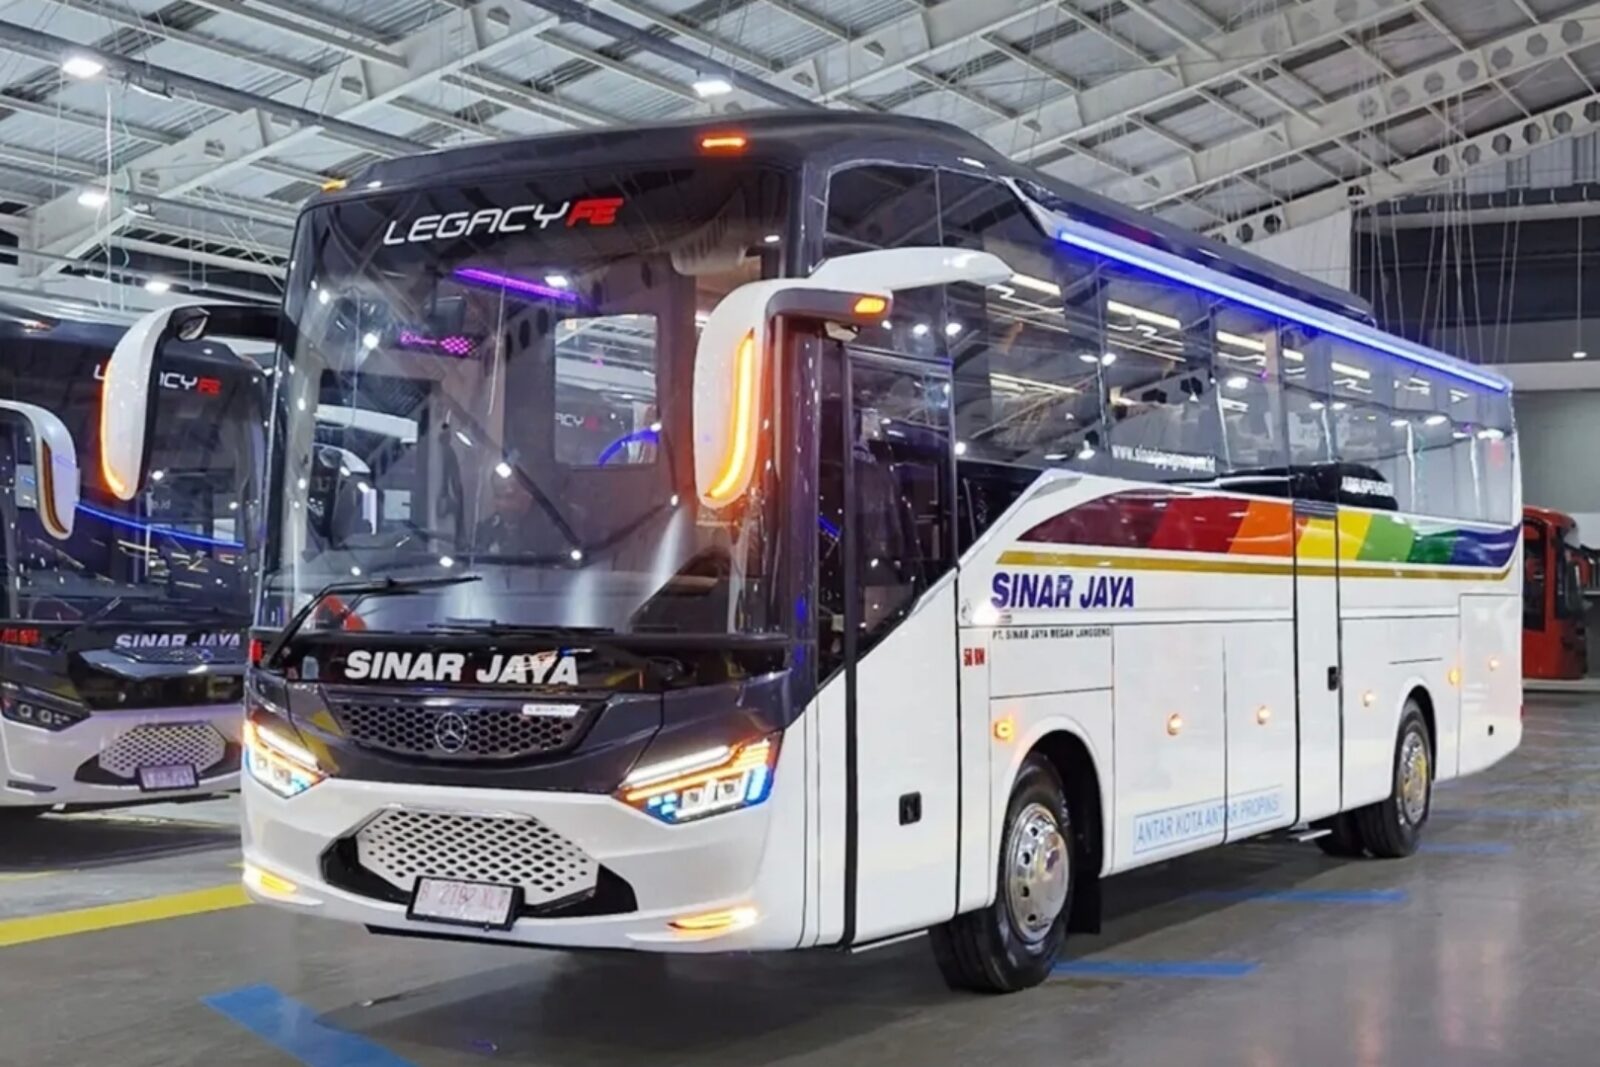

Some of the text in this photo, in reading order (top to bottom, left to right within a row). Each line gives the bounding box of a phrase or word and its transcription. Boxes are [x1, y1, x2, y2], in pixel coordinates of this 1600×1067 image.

[383, 201, 570, 245] LEGACY
[990, 572, 1134, 608] SINAR JAYA
[114, 633, 241, 649] SINAR JAYA
[1006, 629, 1029, 640] SINAR
[1030, 629, 1049, 640] JAYA
[344, 650, 579, 686] SINAR JAYA
[1136, 815, 1174, 844] ANTAR
[1175, 808, 1204, 837] KOTA
